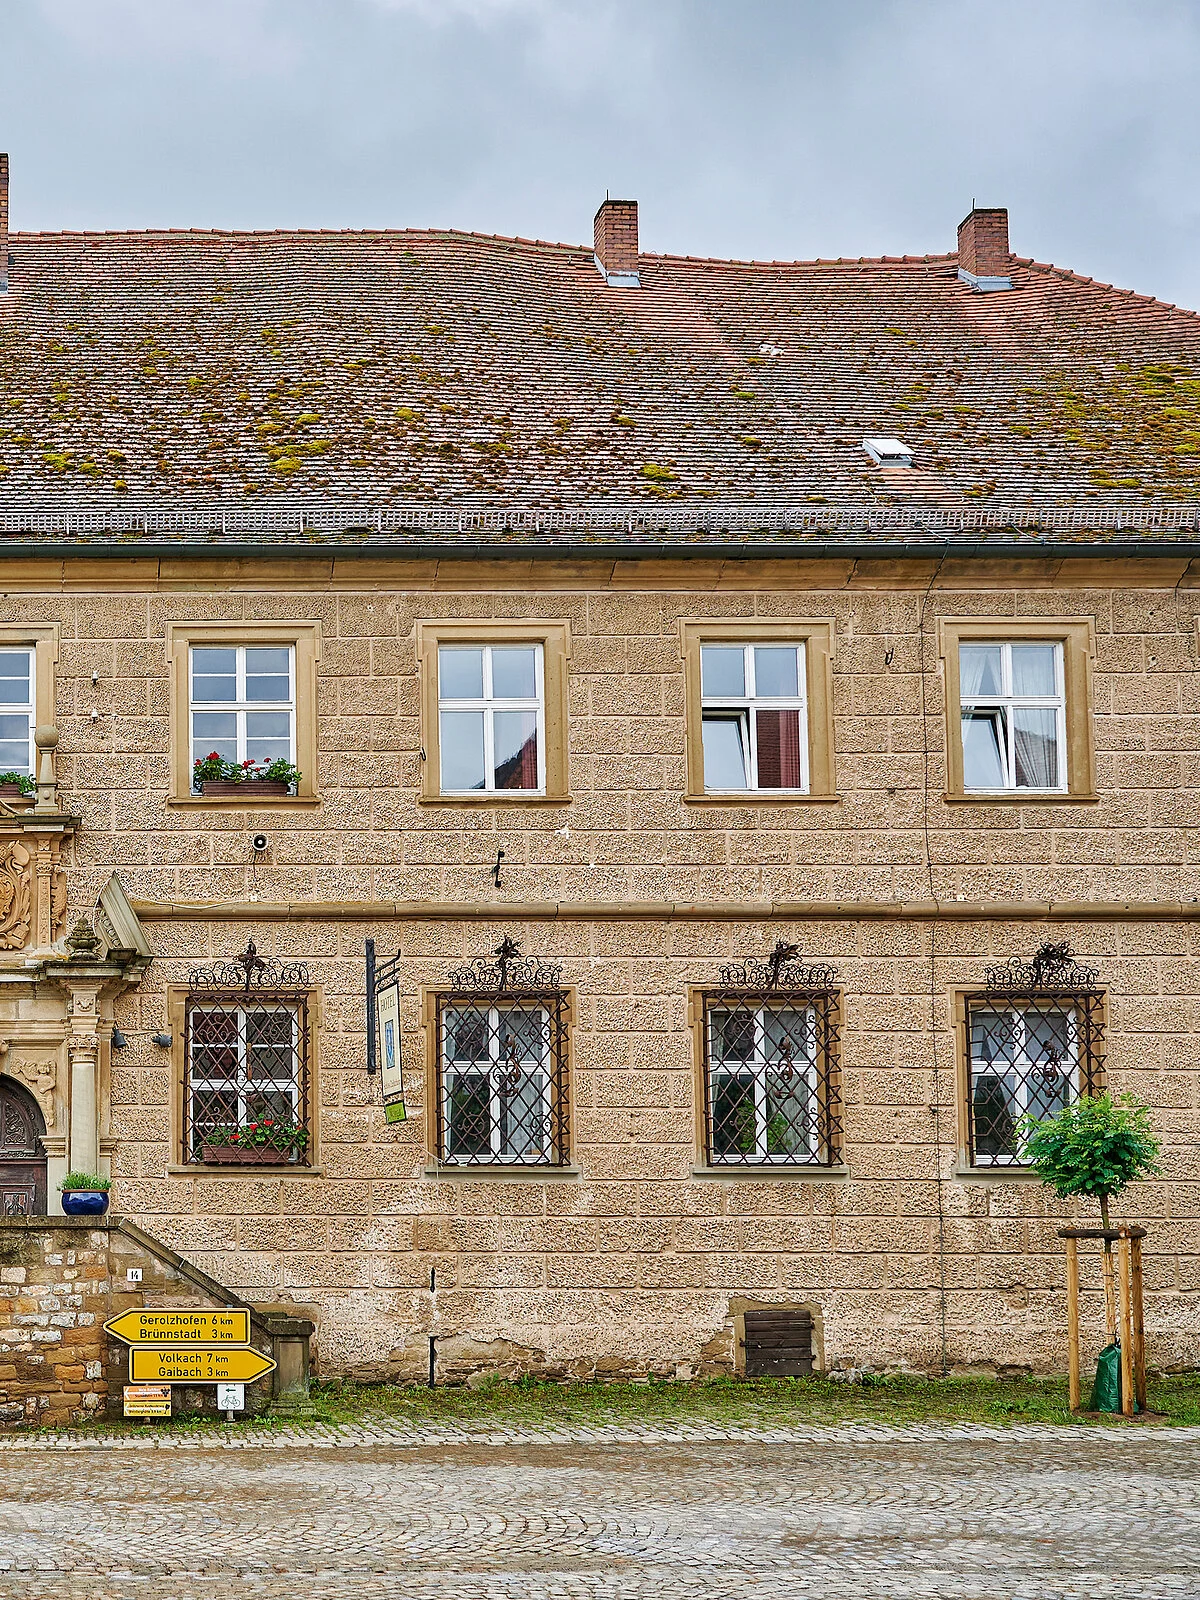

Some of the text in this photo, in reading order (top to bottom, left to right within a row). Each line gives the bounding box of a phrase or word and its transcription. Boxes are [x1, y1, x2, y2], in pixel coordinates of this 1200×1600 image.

[380, 993, 396, 1012] HOTEL
[139, 1315, 233, 1325] Gerolzhofen 6 km
[139, 1328, 233, 1339] Brünnstadt 3 km
[158, 1353, 229, 1363] Volkach 7 km
[158, 1366, 229, 1377] Gaibach 3 km
